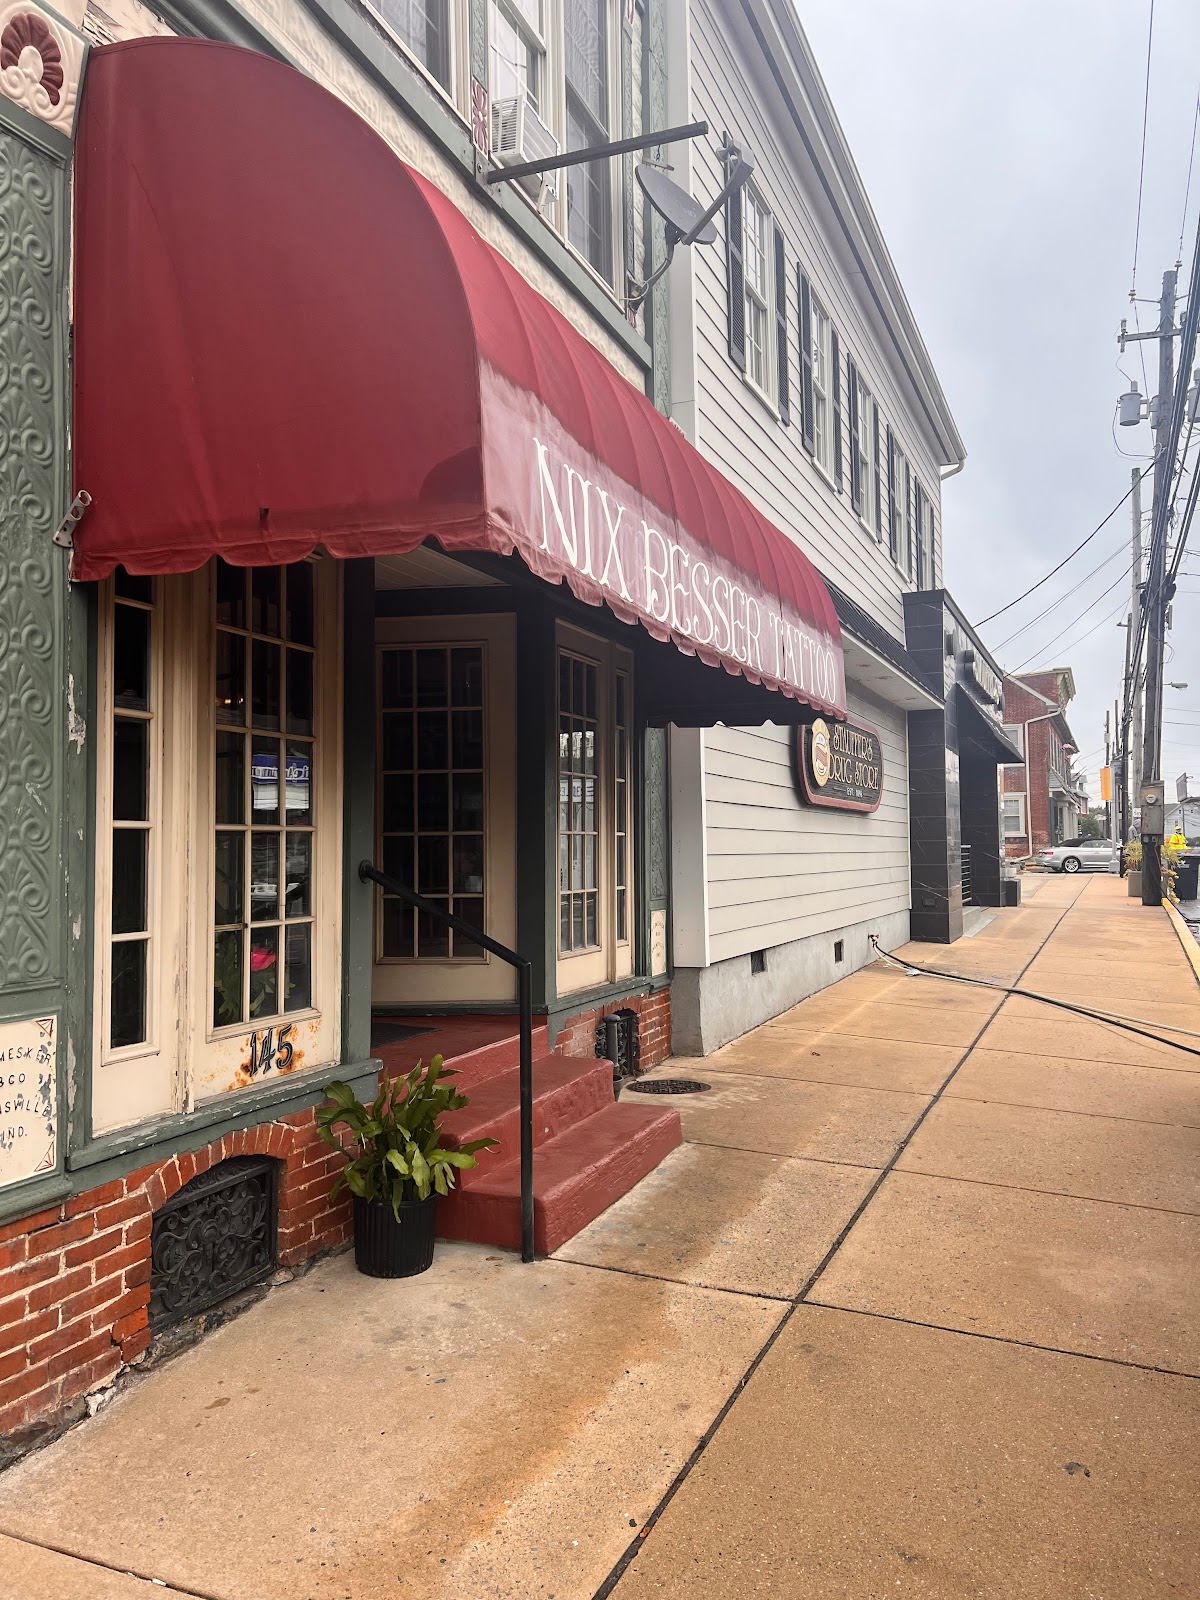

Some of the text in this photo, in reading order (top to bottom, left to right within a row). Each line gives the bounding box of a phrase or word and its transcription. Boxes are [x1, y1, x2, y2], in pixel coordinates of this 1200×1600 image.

[533, 437, 836, 704] NIX BESSER TATTOO
[828, 753, 879, 790] DRUG STORE
[249, 1023, 293, 1078] 145
